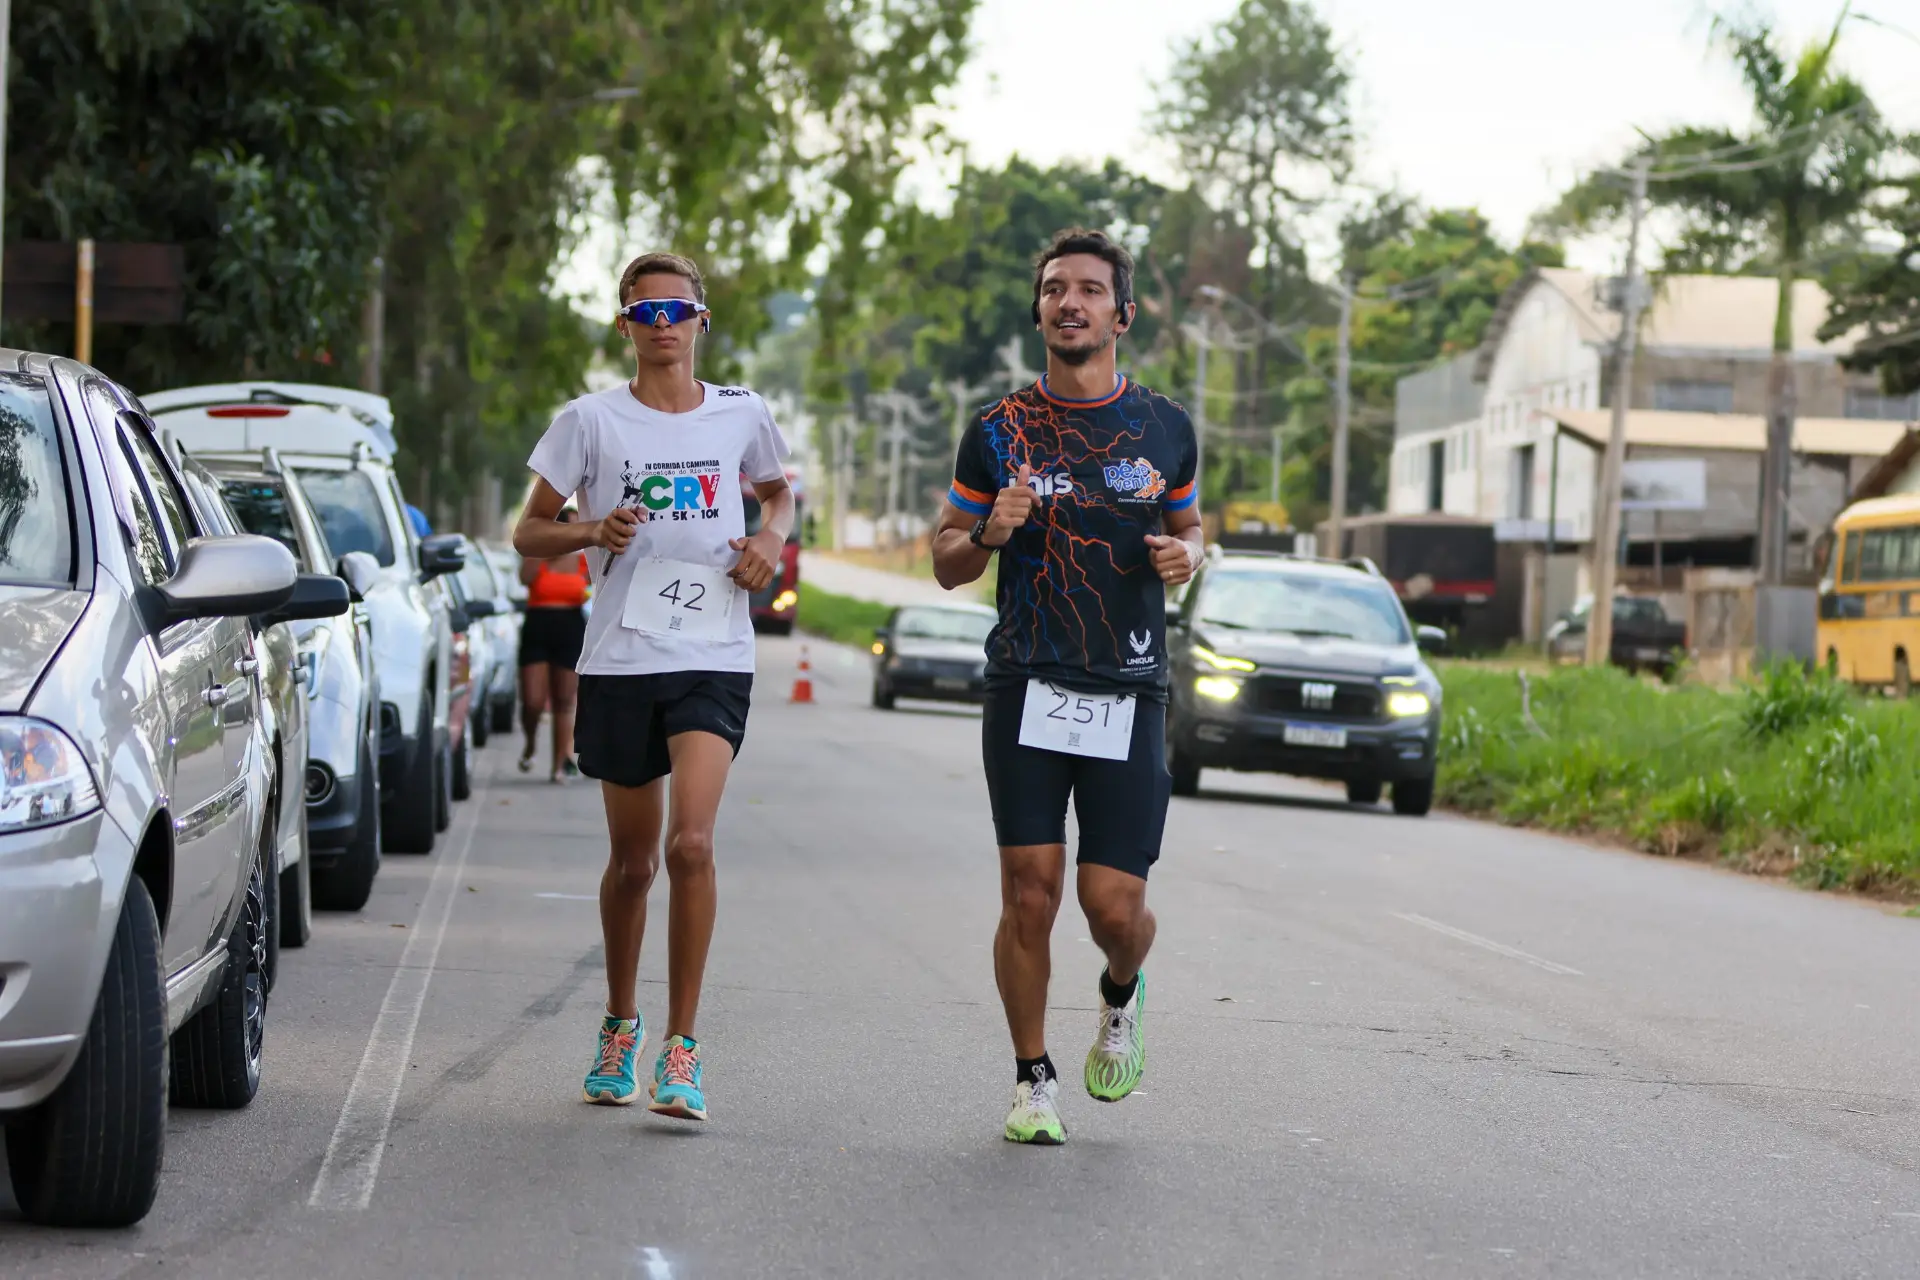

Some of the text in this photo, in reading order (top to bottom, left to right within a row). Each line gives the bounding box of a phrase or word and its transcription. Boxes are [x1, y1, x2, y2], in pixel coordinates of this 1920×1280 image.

[718, 389, 750, 397] 2024
[653, 462, 680, 470] CORRIDA
[686, 460, 719, 468] CAMINHADA
[1103, 459, 1149, 488] pé de
[640, 474, 720, 510] CRV
[672, 511, 688, 521] 5K
[701, 508, 720, 520] 10K
[658, 579, 705, 611] 42
[1126, 655, 1155, 665] UNIQUE
[1046, 692, 1110, 727] 251
